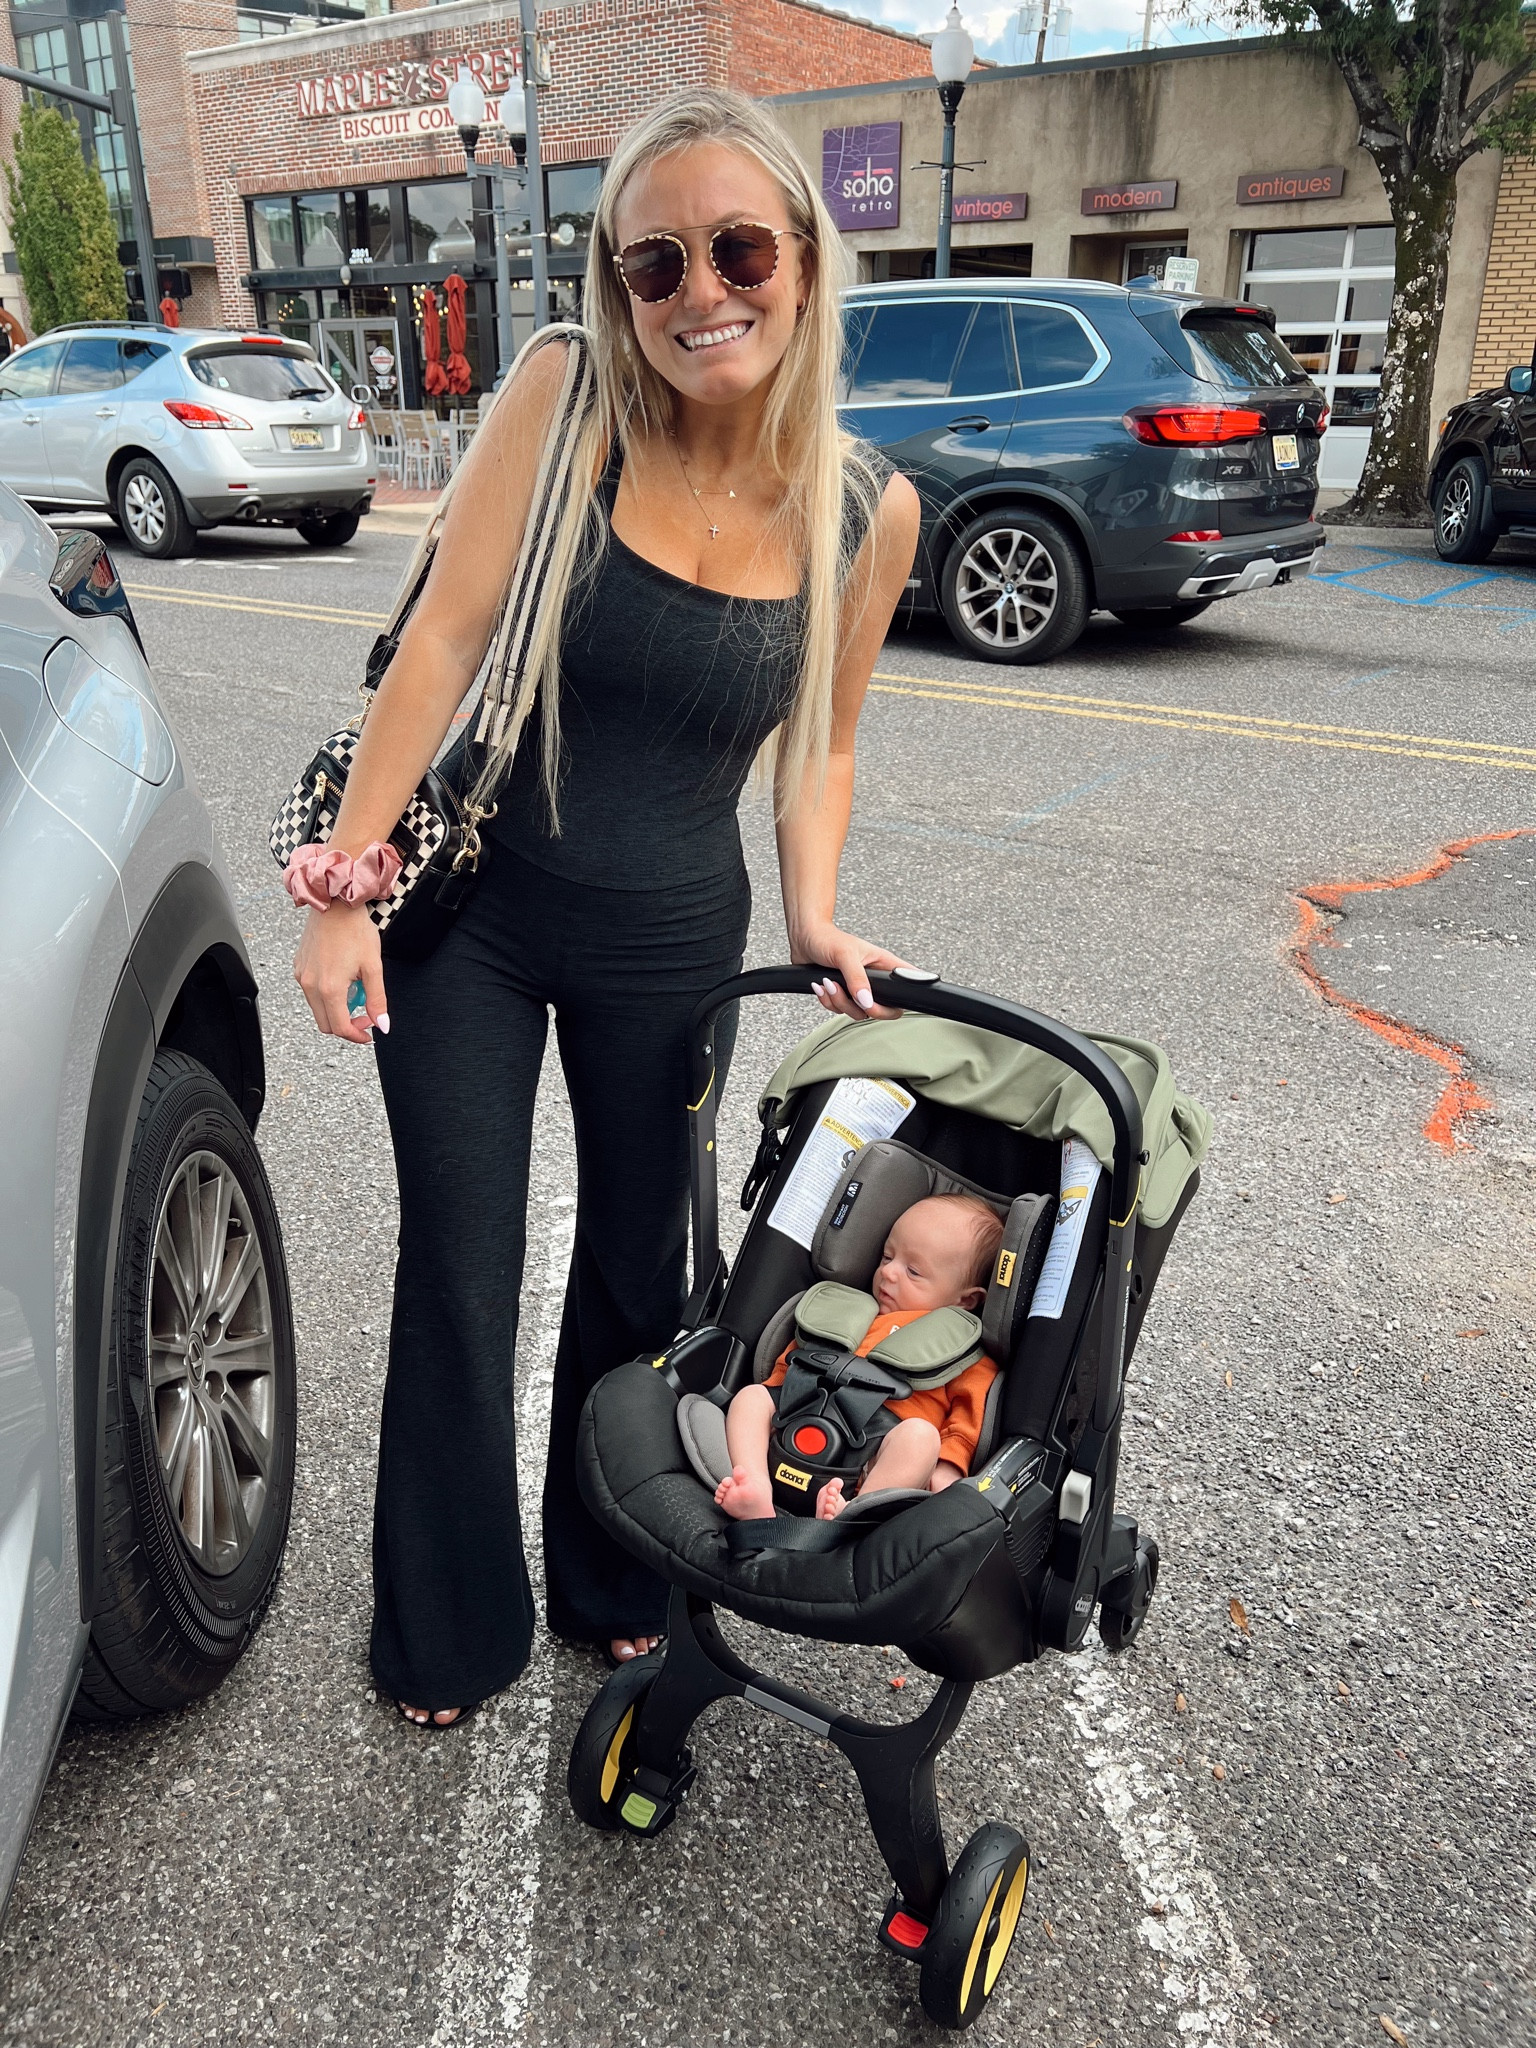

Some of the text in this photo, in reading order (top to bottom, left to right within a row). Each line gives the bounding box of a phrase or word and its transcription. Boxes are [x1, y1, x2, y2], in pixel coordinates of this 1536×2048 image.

[296, 68, 393, 118] MAPLE
[343, 112, 410, 140] BISCUIT
[843, 157, 894, 198] soho
[1247, 176, 1332, 198] antiques
[852, 200, 892, 213] retro
[1093, 189, 1162, 209] modern
[954, 200, 1013, 219] vintage
[1148, 265, 1165, 275] 28
[1168, 272, 1194, 281] PARKING
[1221, 465, 1244, 475] X5
[1501, 468, 1531, 477] TITAN
